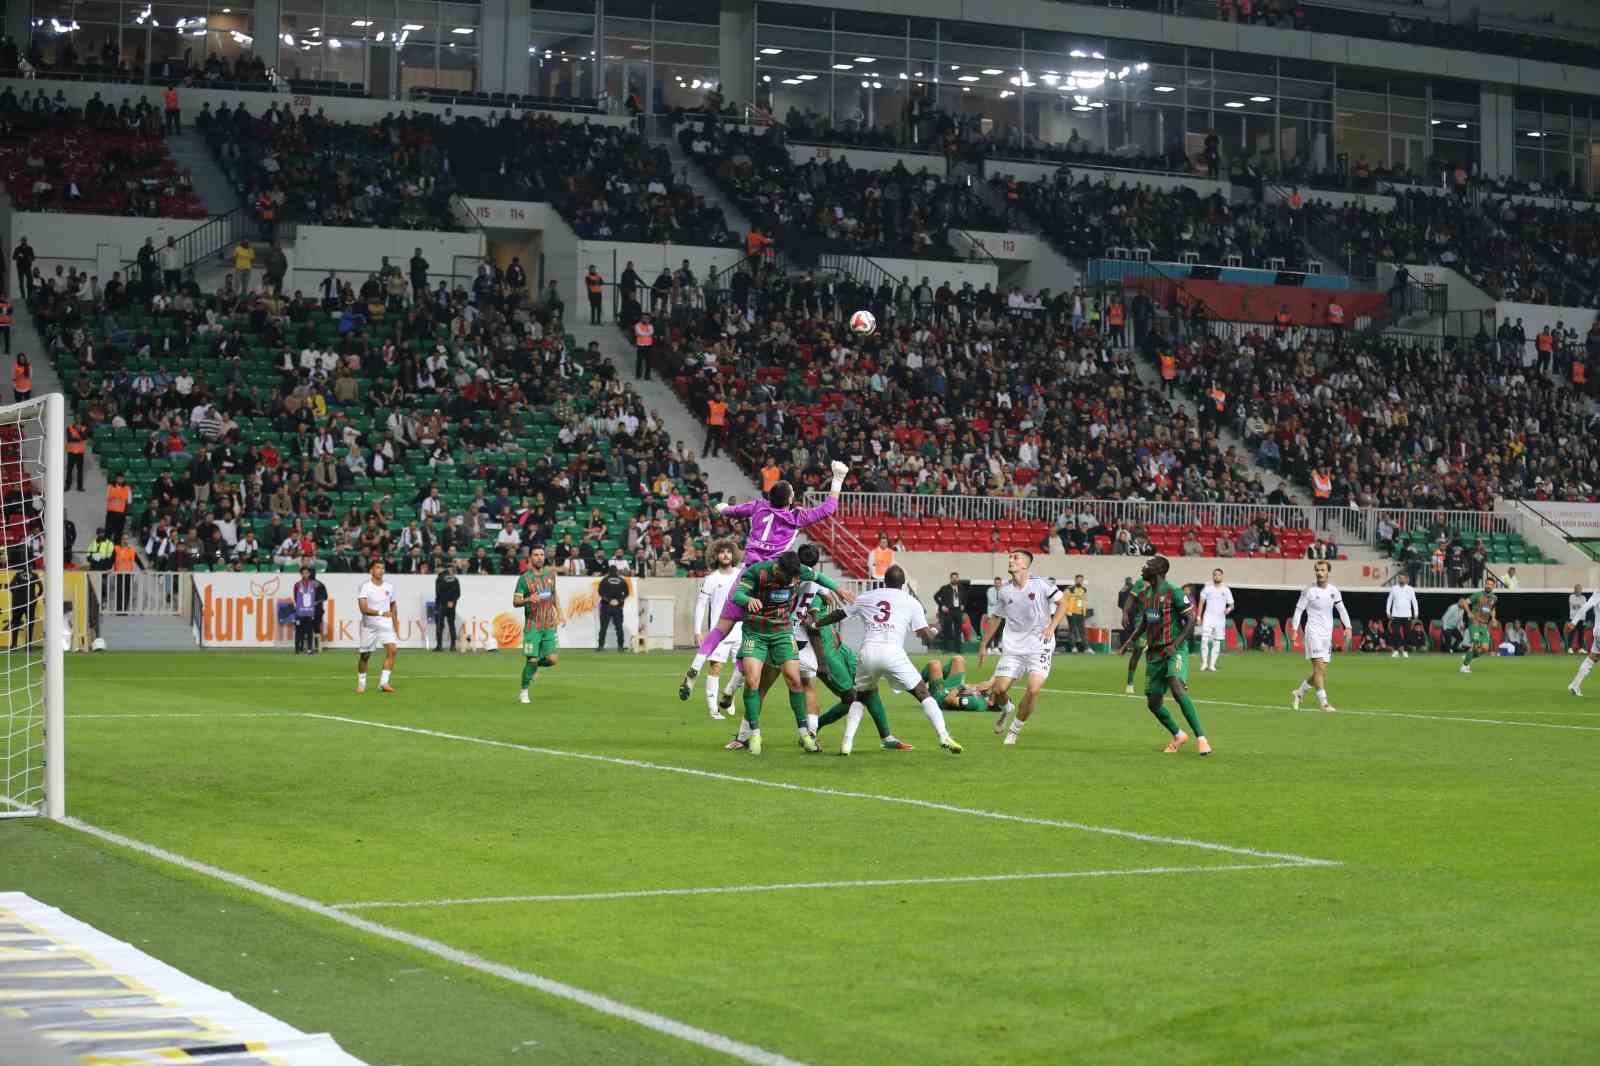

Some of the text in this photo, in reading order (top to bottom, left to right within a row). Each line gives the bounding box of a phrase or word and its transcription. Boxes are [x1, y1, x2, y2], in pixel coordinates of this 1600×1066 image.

[1002, 239, 1016, 252] 113
[761, 512, 775, 542] 1
[873, 600, 891, 623] 3
